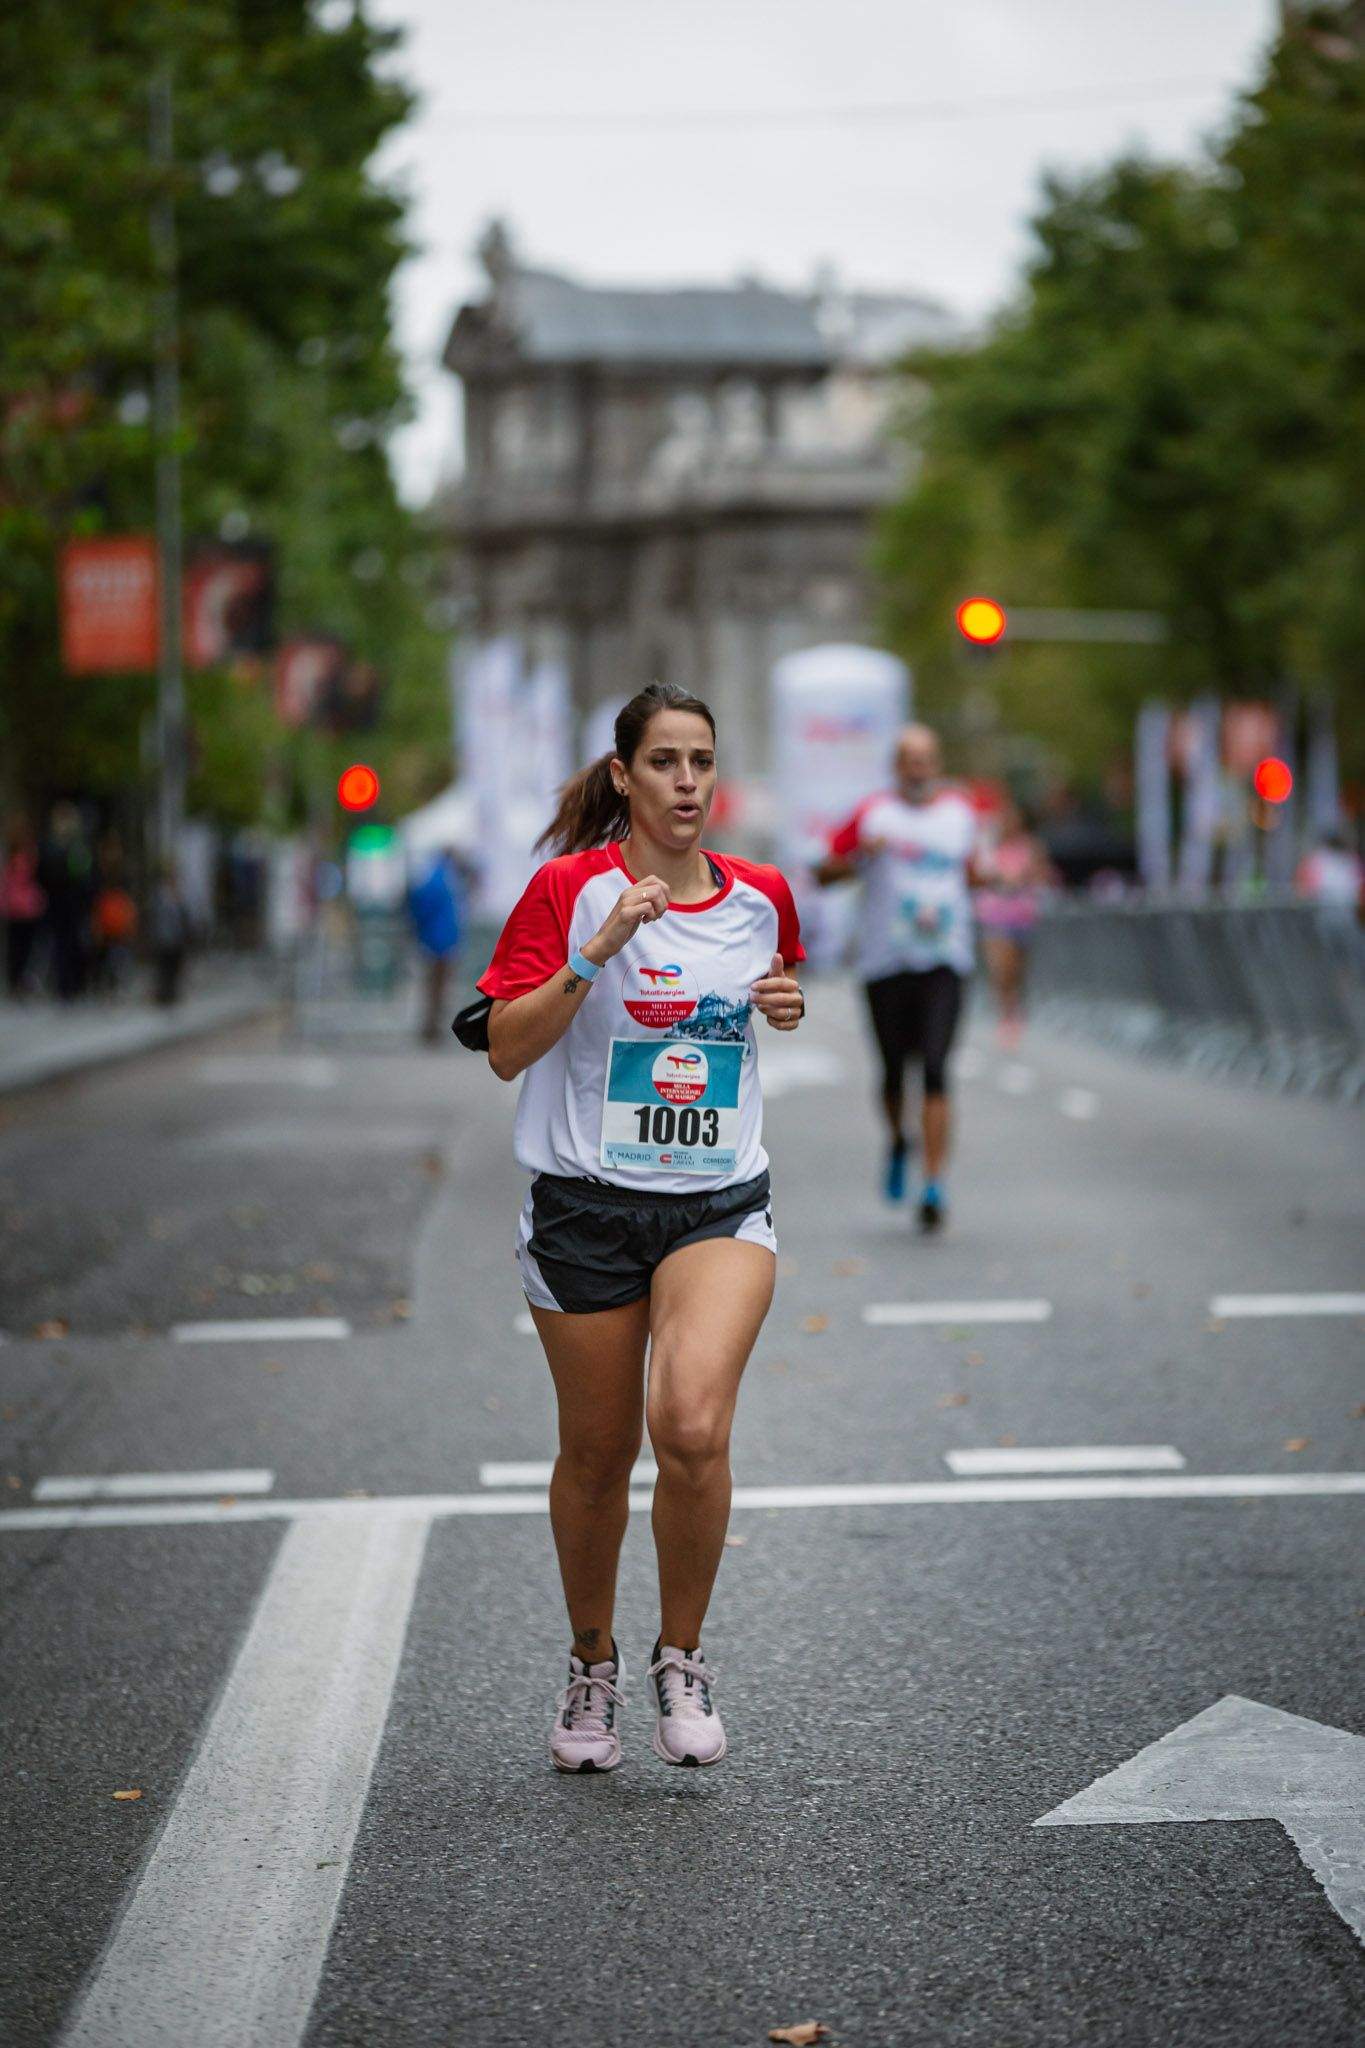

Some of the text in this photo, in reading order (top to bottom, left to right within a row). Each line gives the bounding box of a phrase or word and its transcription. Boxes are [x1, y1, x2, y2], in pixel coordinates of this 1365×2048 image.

[640, 989, 685, 997] TotalEnergies
[634, 1105, 719, 1148] 1003
[617, 1151, 651, 1161] MADRID
